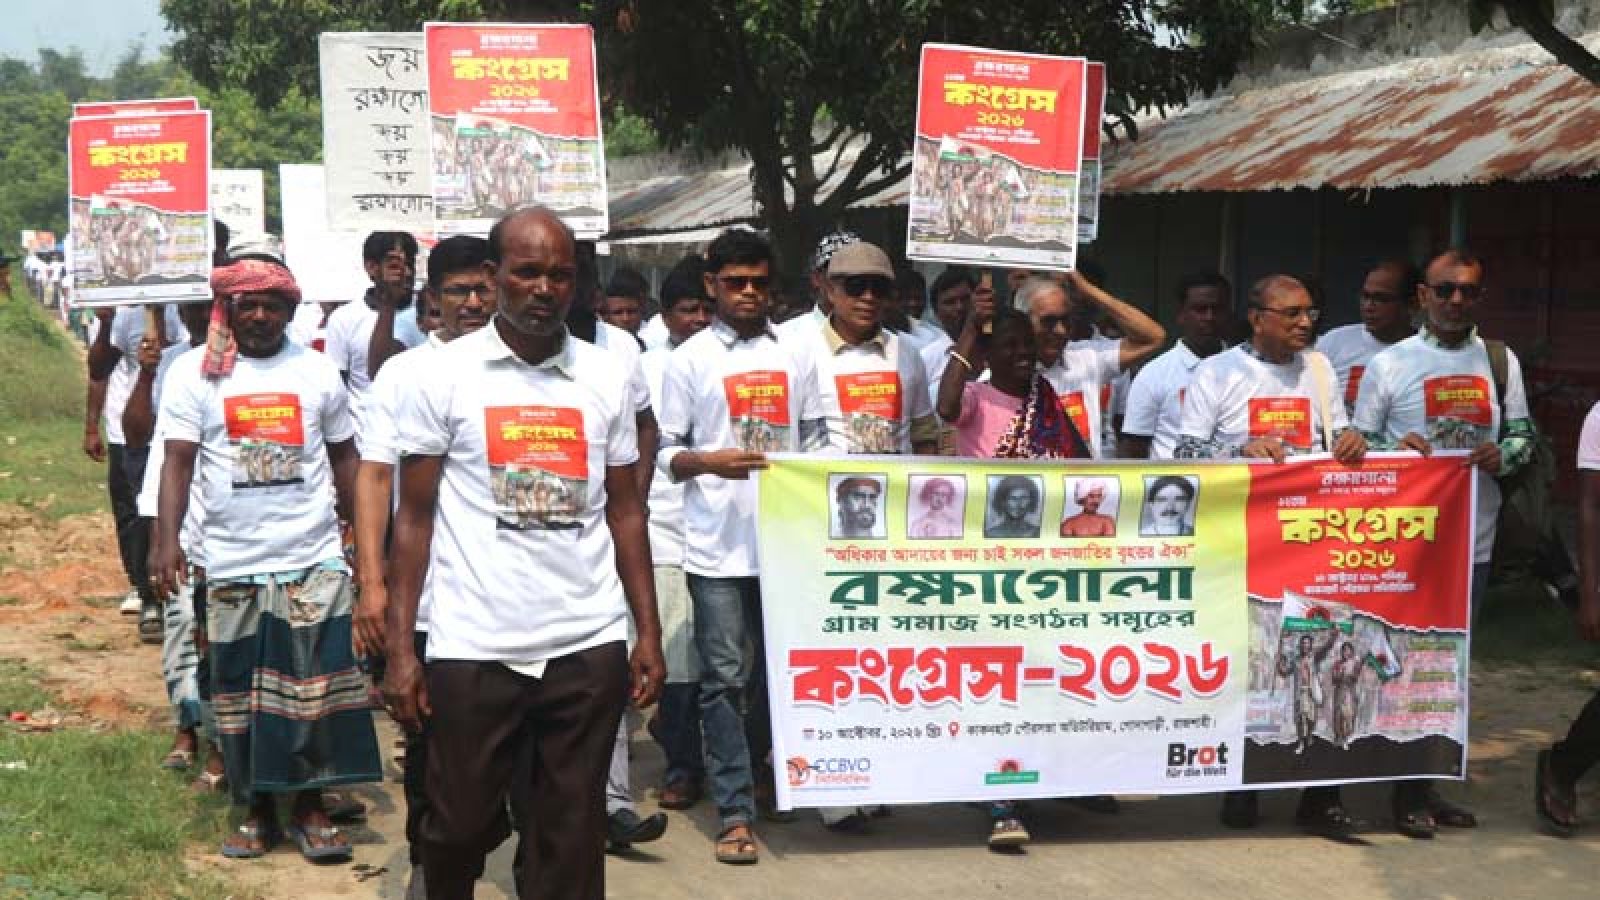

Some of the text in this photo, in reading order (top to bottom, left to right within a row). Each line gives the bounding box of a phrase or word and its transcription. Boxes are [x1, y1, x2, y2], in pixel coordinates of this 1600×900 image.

[367, 46, 419, 79] জয়
[451, 57, 569, 81] কংগ্রেস
[943, 82, 1058, 113] কংগ্রেস
[1277, 506, 1440, 544] কংগ্রেস
[1328, 548, 1397, 568] ২০২৬
[824, 567, 1196, 610] রক্ষাগোলা
[821, 608, 1197, 633] গ্রাম সমাজ সংগঠন সমূহের
[787, 642, 1231, 707] কংগ্রেস-২০২৬
[814, 757, 871, 773] CCBVO
[1167, 742, 1229, 767] Brot
[1184, 767, 1201, 777] die
[1203, 766, 1227, 776] Welt
